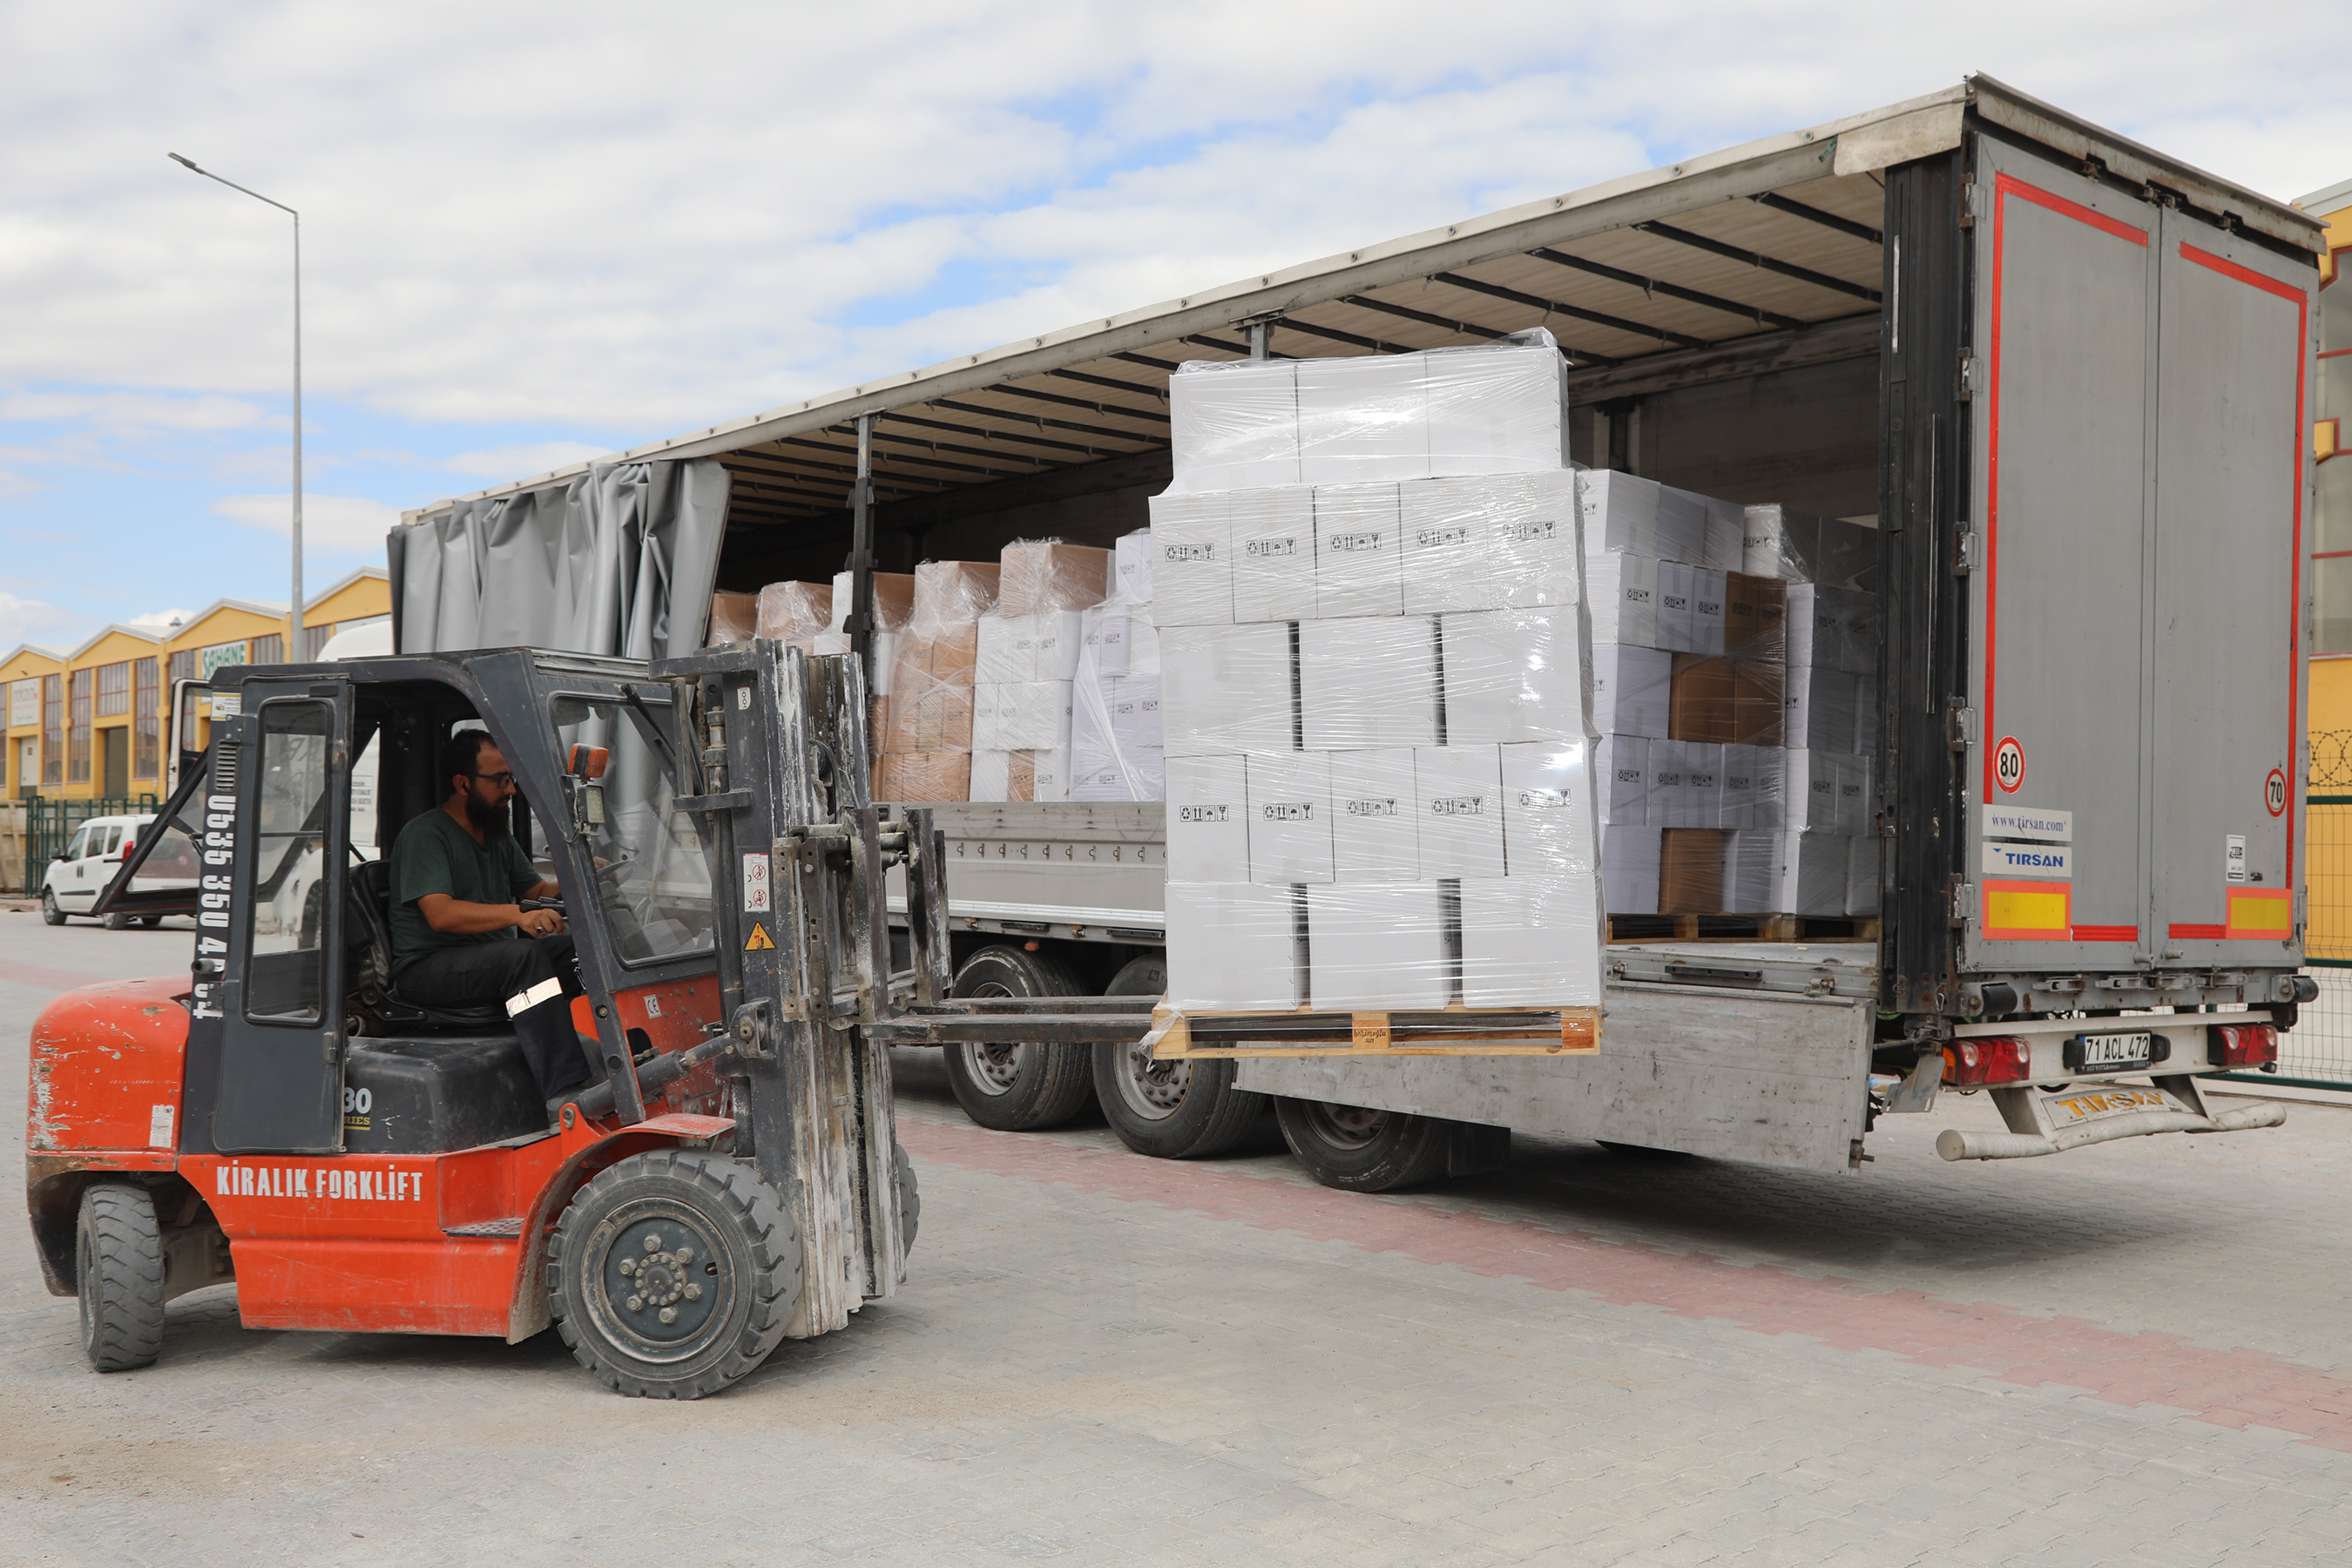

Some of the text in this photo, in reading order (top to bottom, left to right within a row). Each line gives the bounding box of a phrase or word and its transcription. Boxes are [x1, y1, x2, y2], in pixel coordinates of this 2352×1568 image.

[2000, 752, 2018, 777] 80
[2270, 781, 2282, 803] 70
[203, 794, 236, 865] 0535
[1992, 815, 2064, 832] www.tirsan.com
[2005, 853, 2064, 868] TIRSAN
[200, 875, 232, 928] 350
[2086, 1036, 2149, 1061] 71 ACL 472
[344, 1086, 372, 1114] 30
[344, 1116, 371, 1125] RIES
[216, 1159, 422, 1201] KİRALIK FORKLİFT
